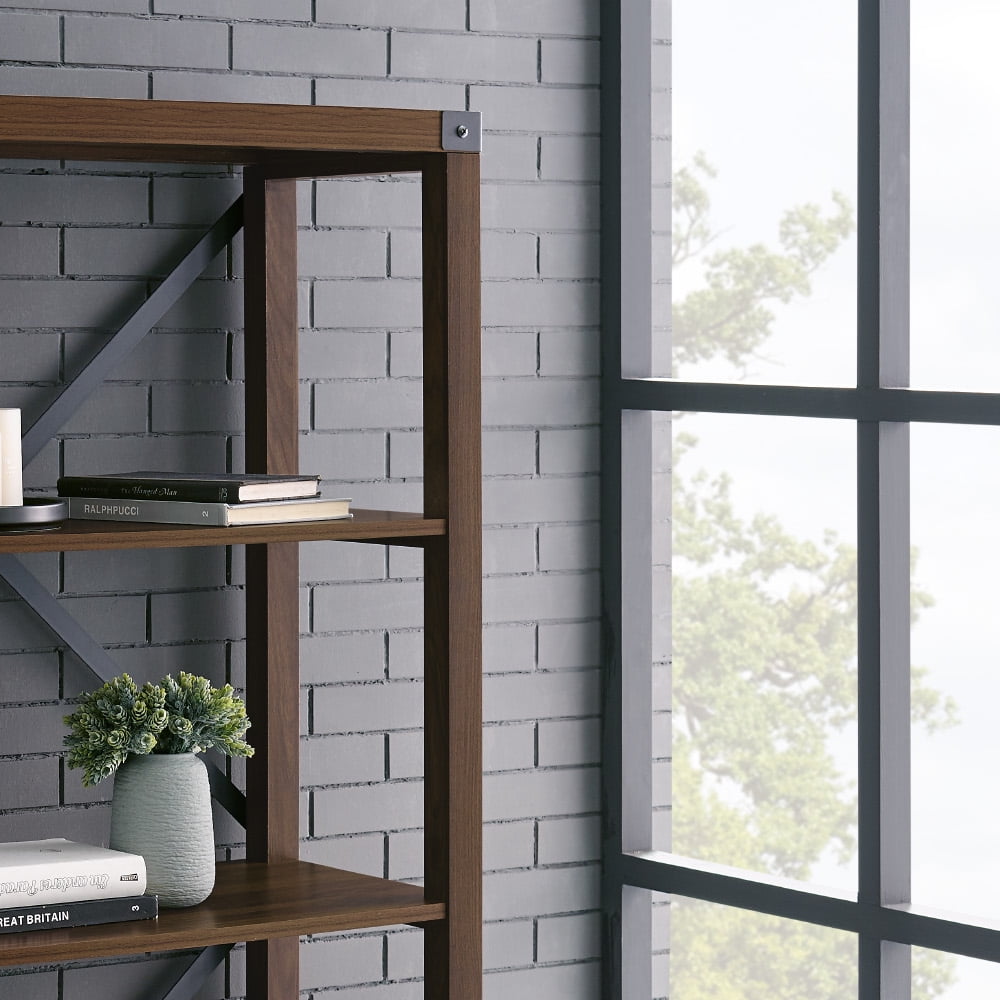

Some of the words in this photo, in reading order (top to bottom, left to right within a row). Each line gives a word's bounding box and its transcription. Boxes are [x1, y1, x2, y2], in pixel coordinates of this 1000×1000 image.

[158, 487, 177, 496] Man
[84, 504, 139, 516] RALPHPUCCI
[131, 904, 140, 912] 3
[26, 910, 69, 925] BRITAIN
